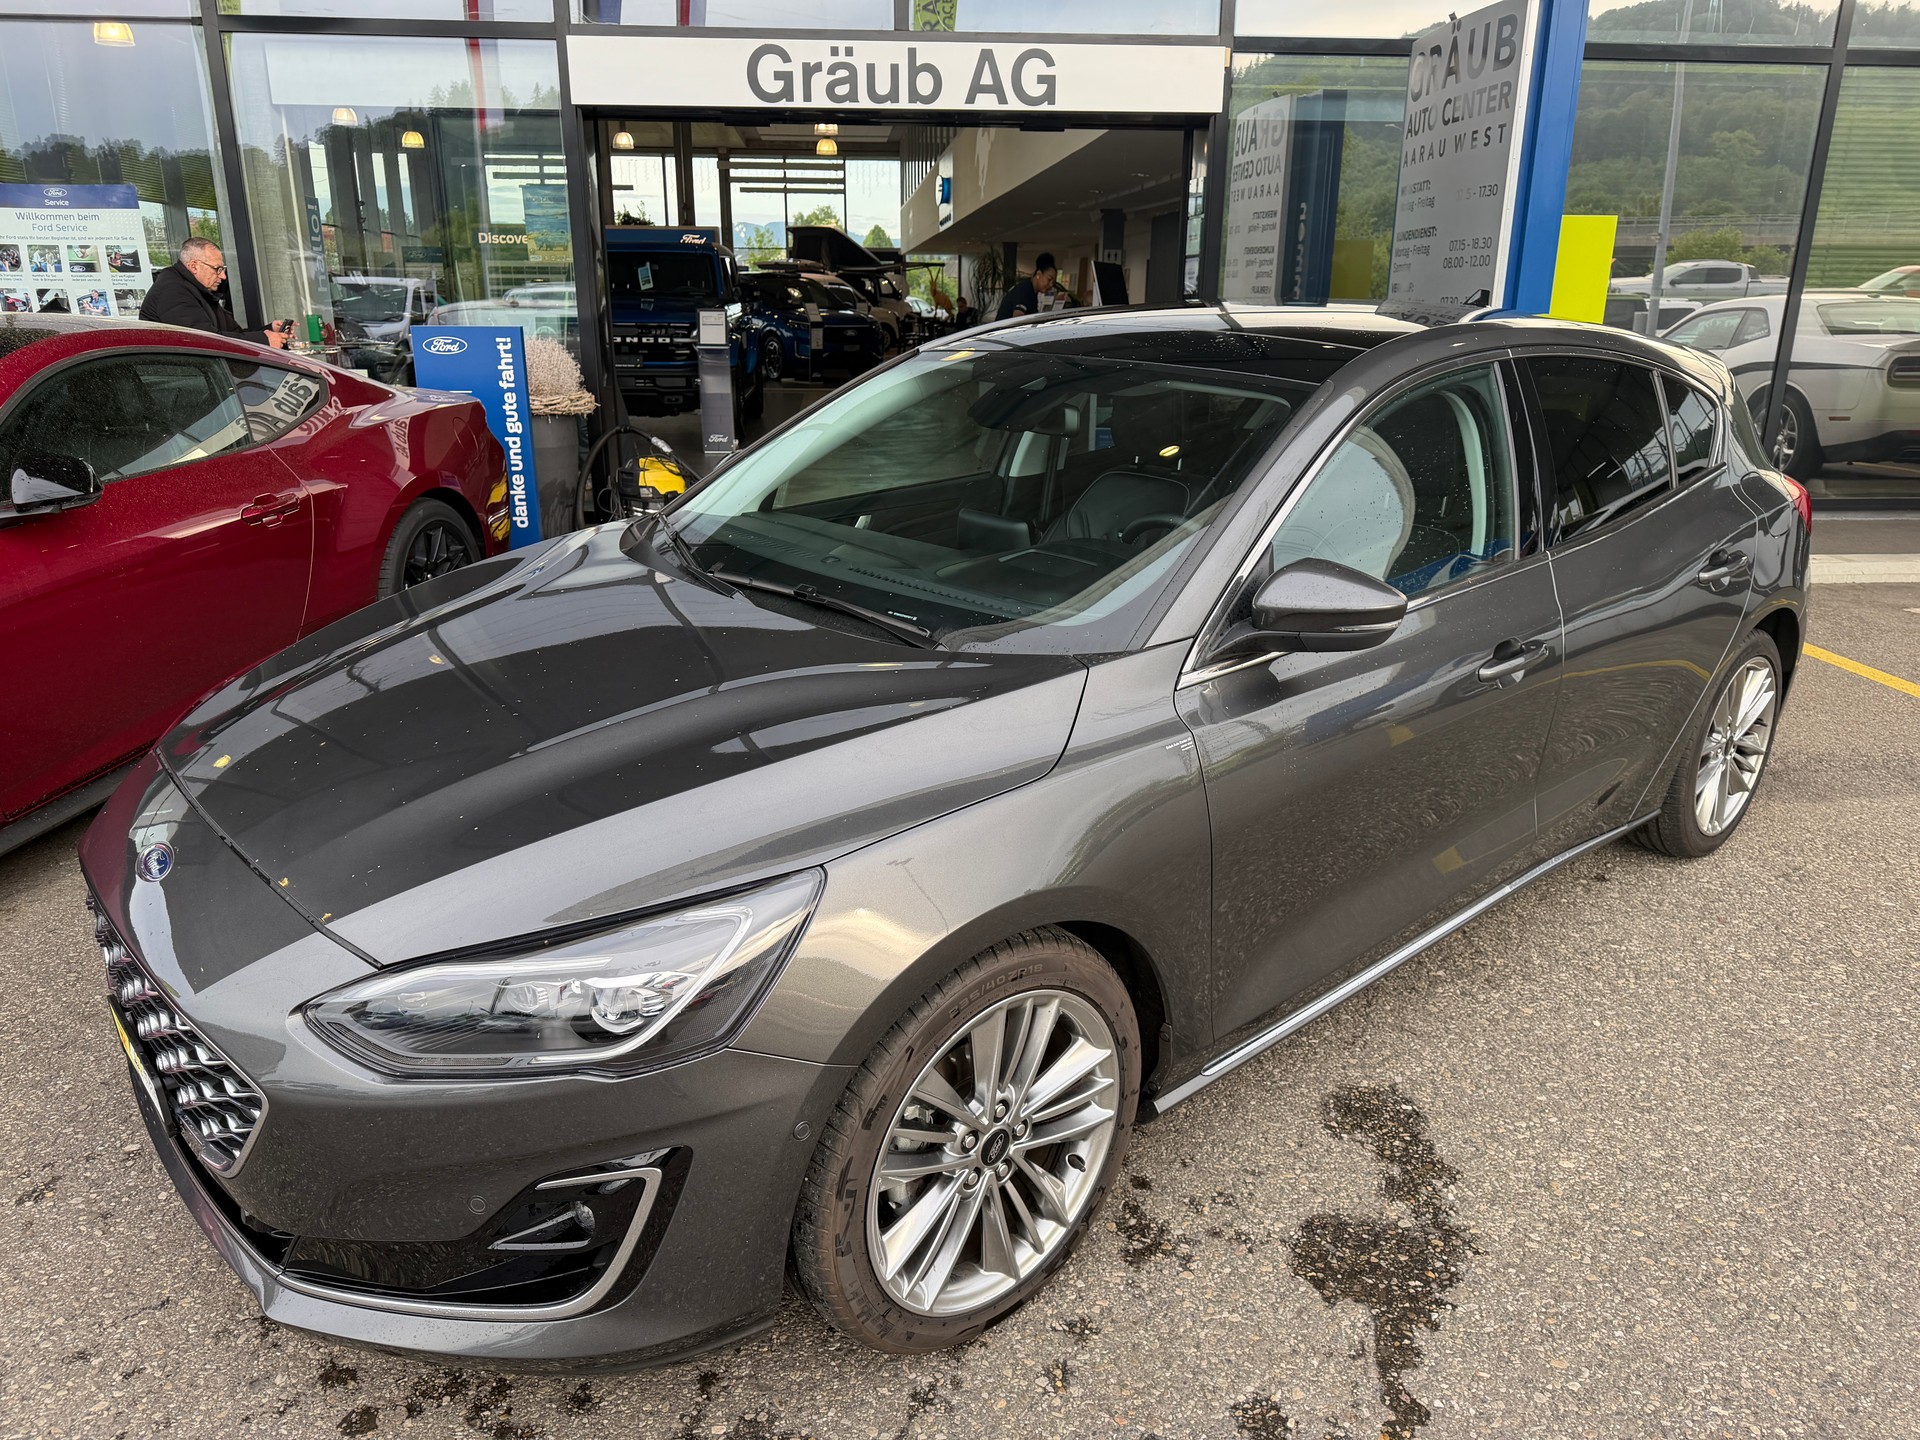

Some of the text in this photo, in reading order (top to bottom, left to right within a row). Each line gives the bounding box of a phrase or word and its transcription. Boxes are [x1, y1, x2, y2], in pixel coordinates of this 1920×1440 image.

[1411, 13, 1518, 103] GRÄUB
[746, 43, 1056, 107] Gräub AG
[1405, 80, 1512, 140] AUTO CENTER
[1403, 123, 1507, 168] AARAU WEST
[1478, 183, 1499, 198] 17.30
[44, 199, 70, 207] Service
[15, 212, 100, 221] Willkommen beim
[32, 223, 88, 232] Ford Service
[478, 232, 529, 245] Discove
[1449, 239, 1466, 252] 07.15
[1471, 236, 1493, 250] 18.30
[1442, 257, 1464, 269] 08.00
[1470, 254, 1491, 268] 12.00
[429, 338, 460, 353] Ford
[495, 337, 529, 528] danke und gute fahrt!
[709, 434, 729, 443] Ford
